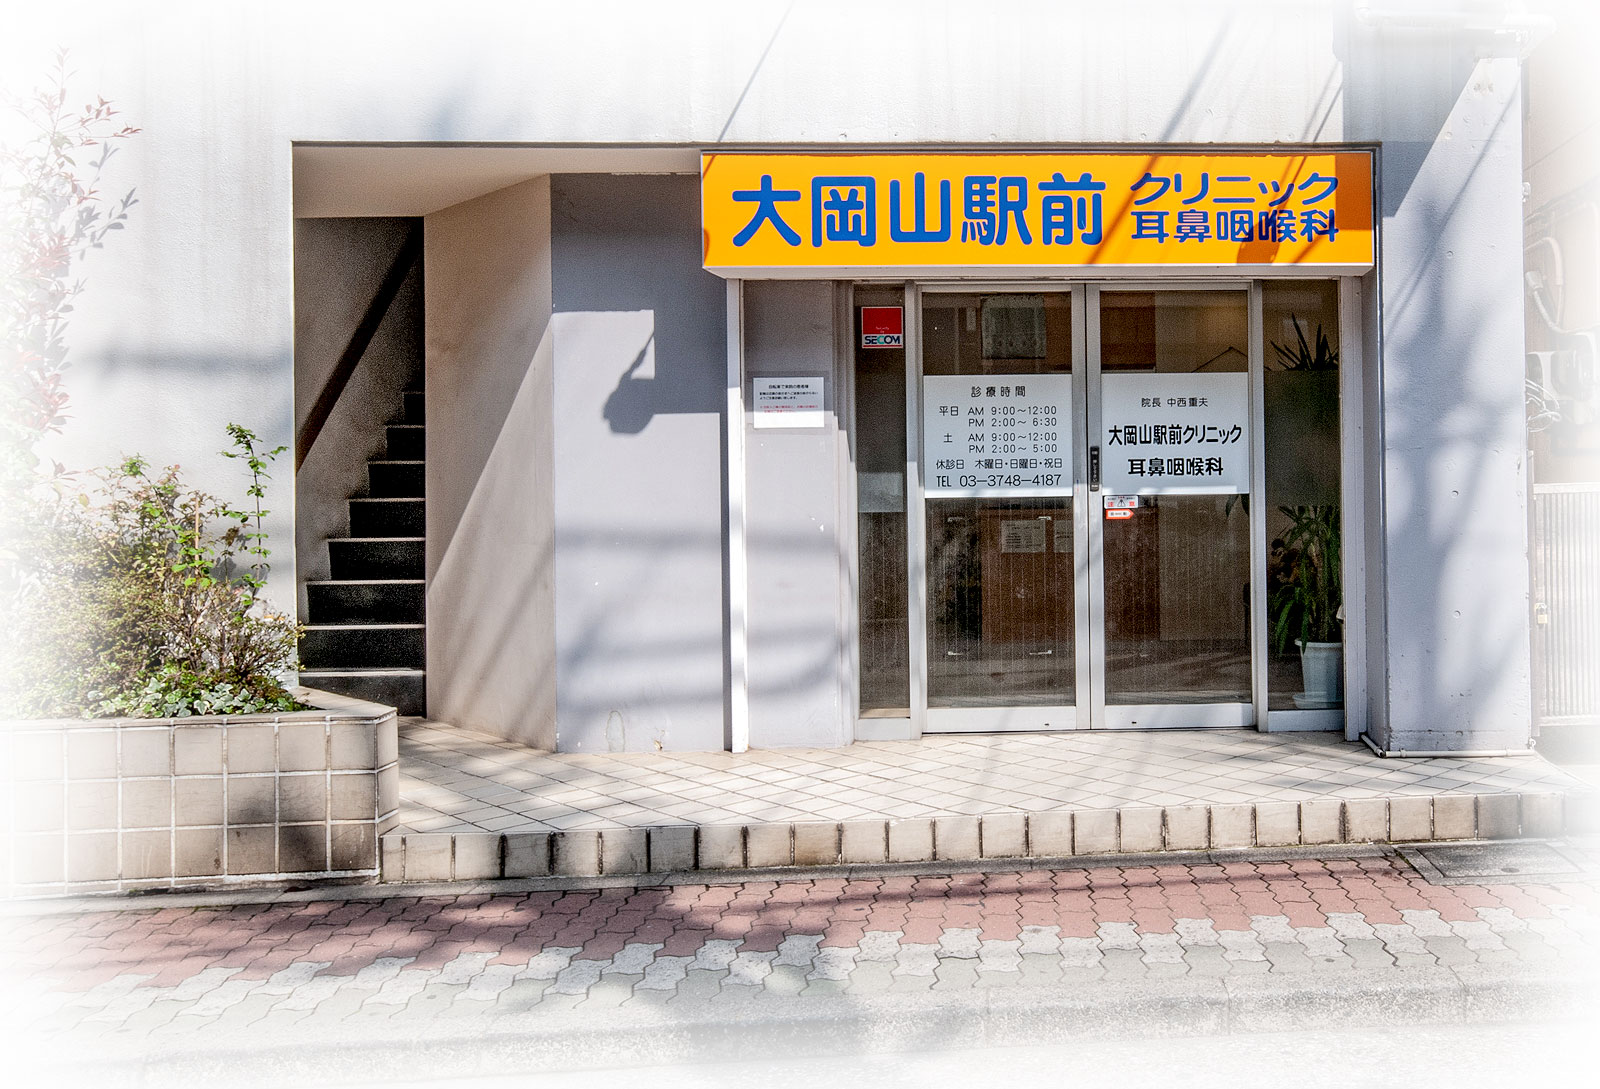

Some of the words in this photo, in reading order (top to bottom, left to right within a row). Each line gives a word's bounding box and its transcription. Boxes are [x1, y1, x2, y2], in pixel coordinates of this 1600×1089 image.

[1131, 172, 1339, 206] クリニック
[732, 171, 1106, 247] 大岡山駅前
[1131, 208, 1339, 244] 耳鼻咽喉科
[864, 335, 900, 345] SECOM
[971, 386, 1026, 397] 診療時間
[1141, 398, 1161, 407] 院長
[939, 406, 959, 416] 平日
[968, 407, 984, 415] AM
[969, 418, 984, 427] PM
[943, 433, 952, 443] 土
[968, 433, 984, 442] AM
[1109, 424, 1242, 445] 大岡山駅前クリニック
[969, 445, 984, 453] PM
[936, 459, 964, 470] 休診日
[1128, 457, 1223, 476] 耳鼻咽喉科
[936, 475, 951, 487] TEL
